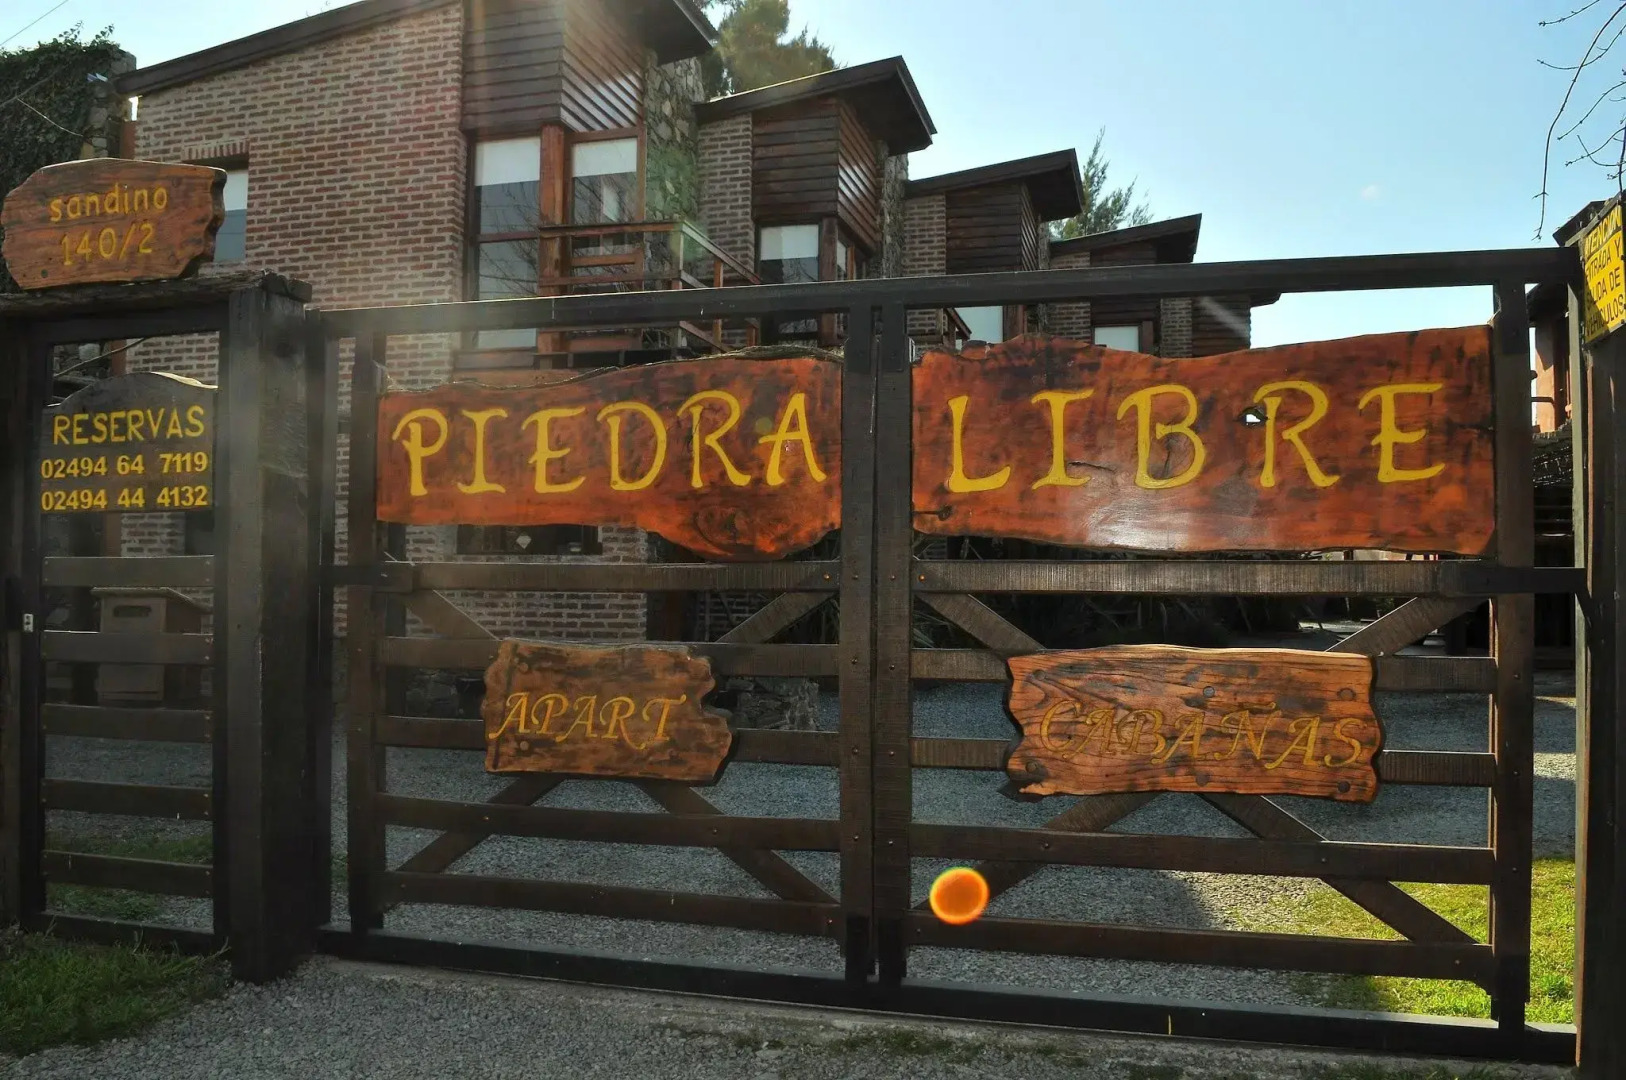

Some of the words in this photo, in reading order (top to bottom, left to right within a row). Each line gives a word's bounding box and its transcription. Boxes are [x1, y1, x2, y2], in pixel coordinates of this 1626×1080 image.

[50, 183, 169, 222] sandino
[60, 223, 154, 266] 140/2
[1614, 237, 1621, 257] Y
[1609, 267, 1621, 291] DE
[53, 406, 205, 445] RESERVAS
[392, 390, 827, 496] PIEDRA
[948, 380, 1446, 493] LIBRE
[41, 456, 107, 479] 02494
[116, 455, 145, 475] 64
[159, 452, 208, 473] 7119
[41, 489, 107, 511] 02494
[117, 488, 145, 508] 44
[157, 485, 209, 507] 4132
[488, 692, 687, 750] APART
[1039, 700, 1368, 769] CABAÑAS
